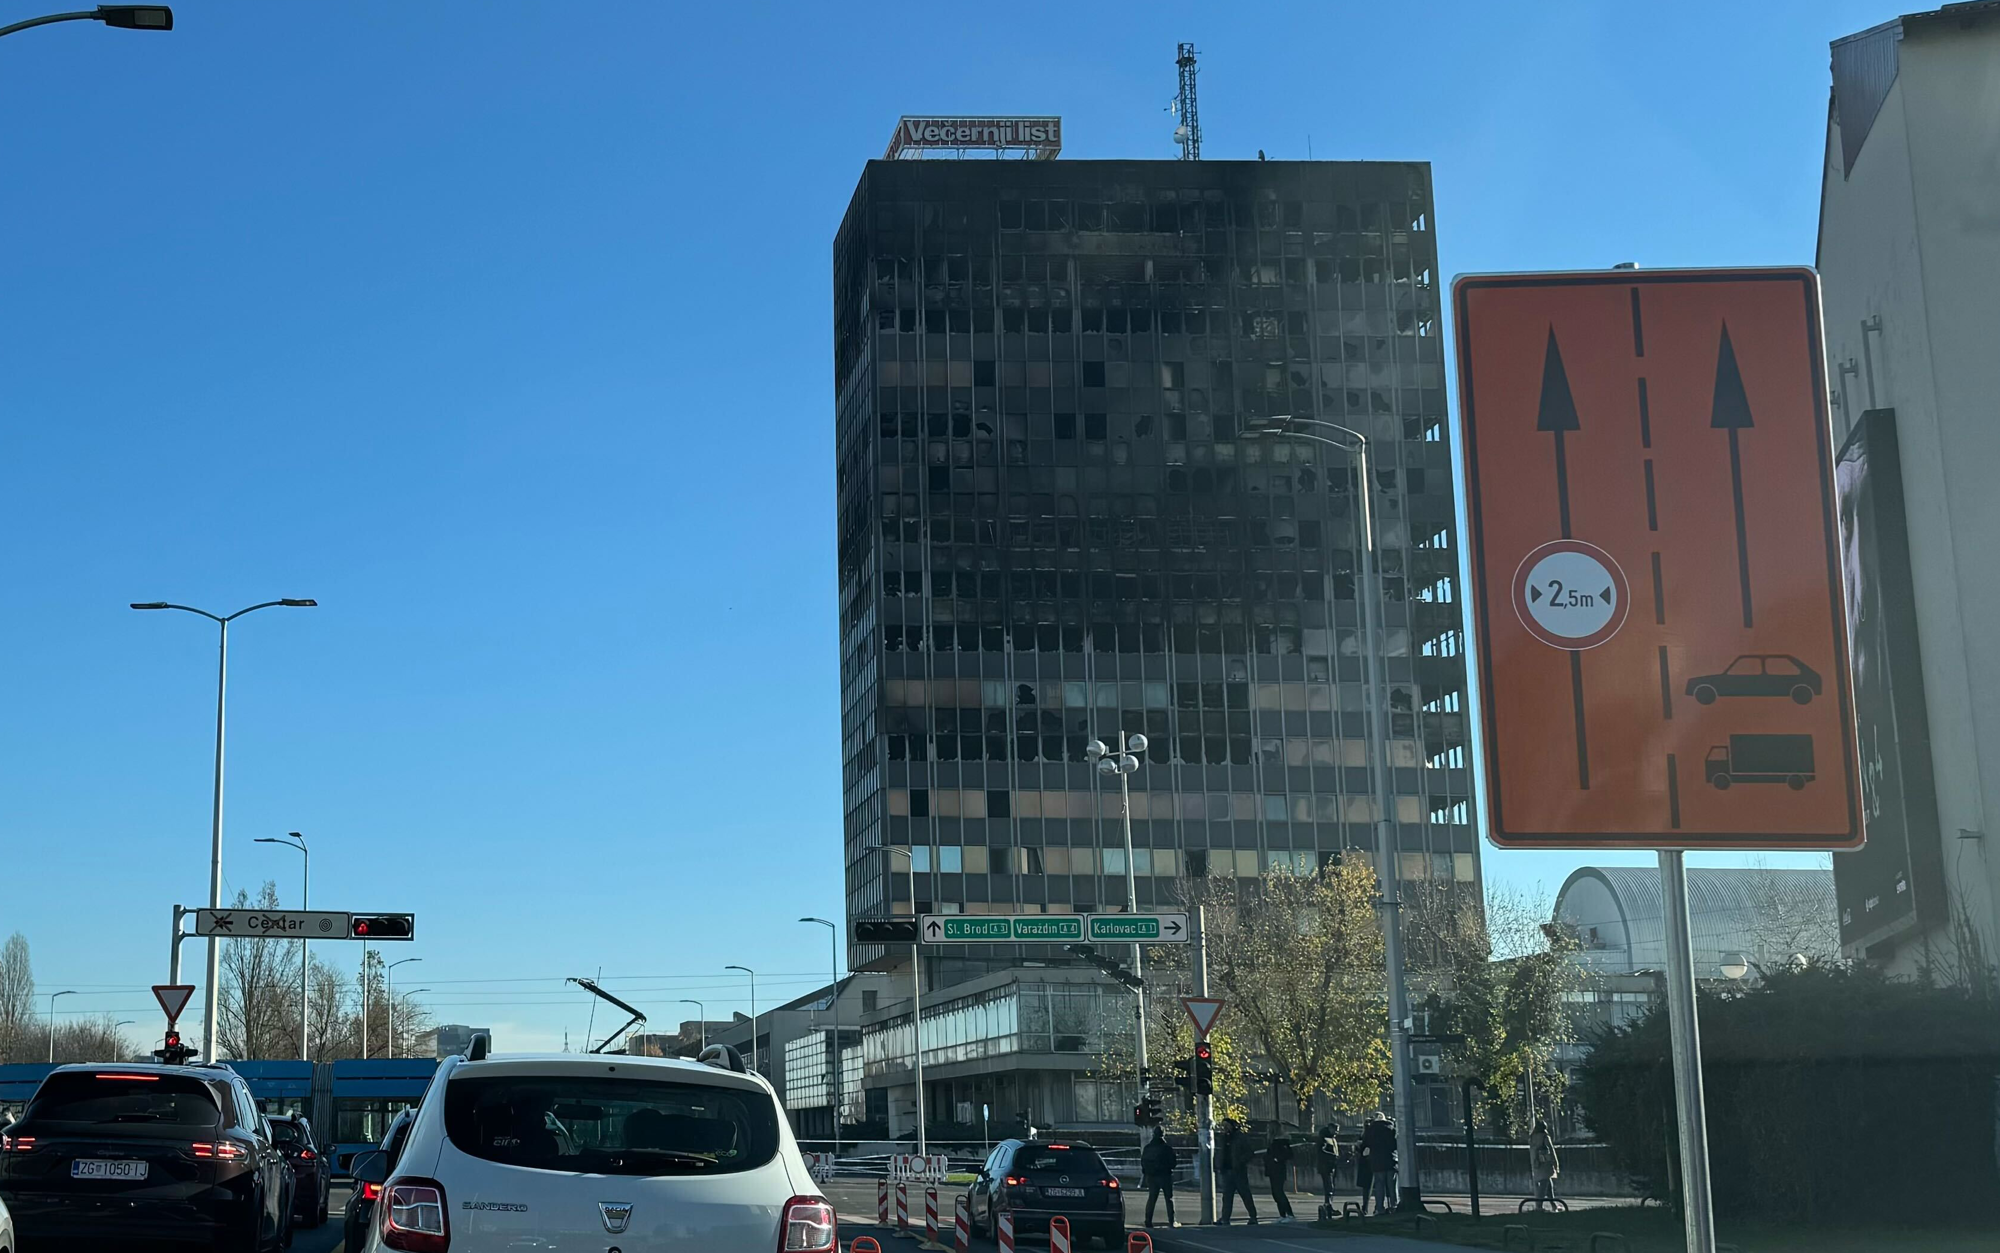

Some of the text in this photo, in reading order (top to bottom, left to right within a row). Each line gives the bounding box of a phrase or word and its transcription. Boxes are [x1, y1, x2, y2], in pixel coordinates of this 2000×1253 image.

[905, 120, 1012, 146] Večernji
[1018, 121, 1059, 141] list
[1548, 579, 1594, 609] 2,5m
[947, 923, 960, 935] Sl.
[964, 923, 987, 934] Brod
[1015, 921, 1058, 935] Varaždin
[1094, 922, 1137, 934] Karlovac
[80, 1162, 95, 1175] ZG
[462, 1201, 528, 1213] SANDERO
